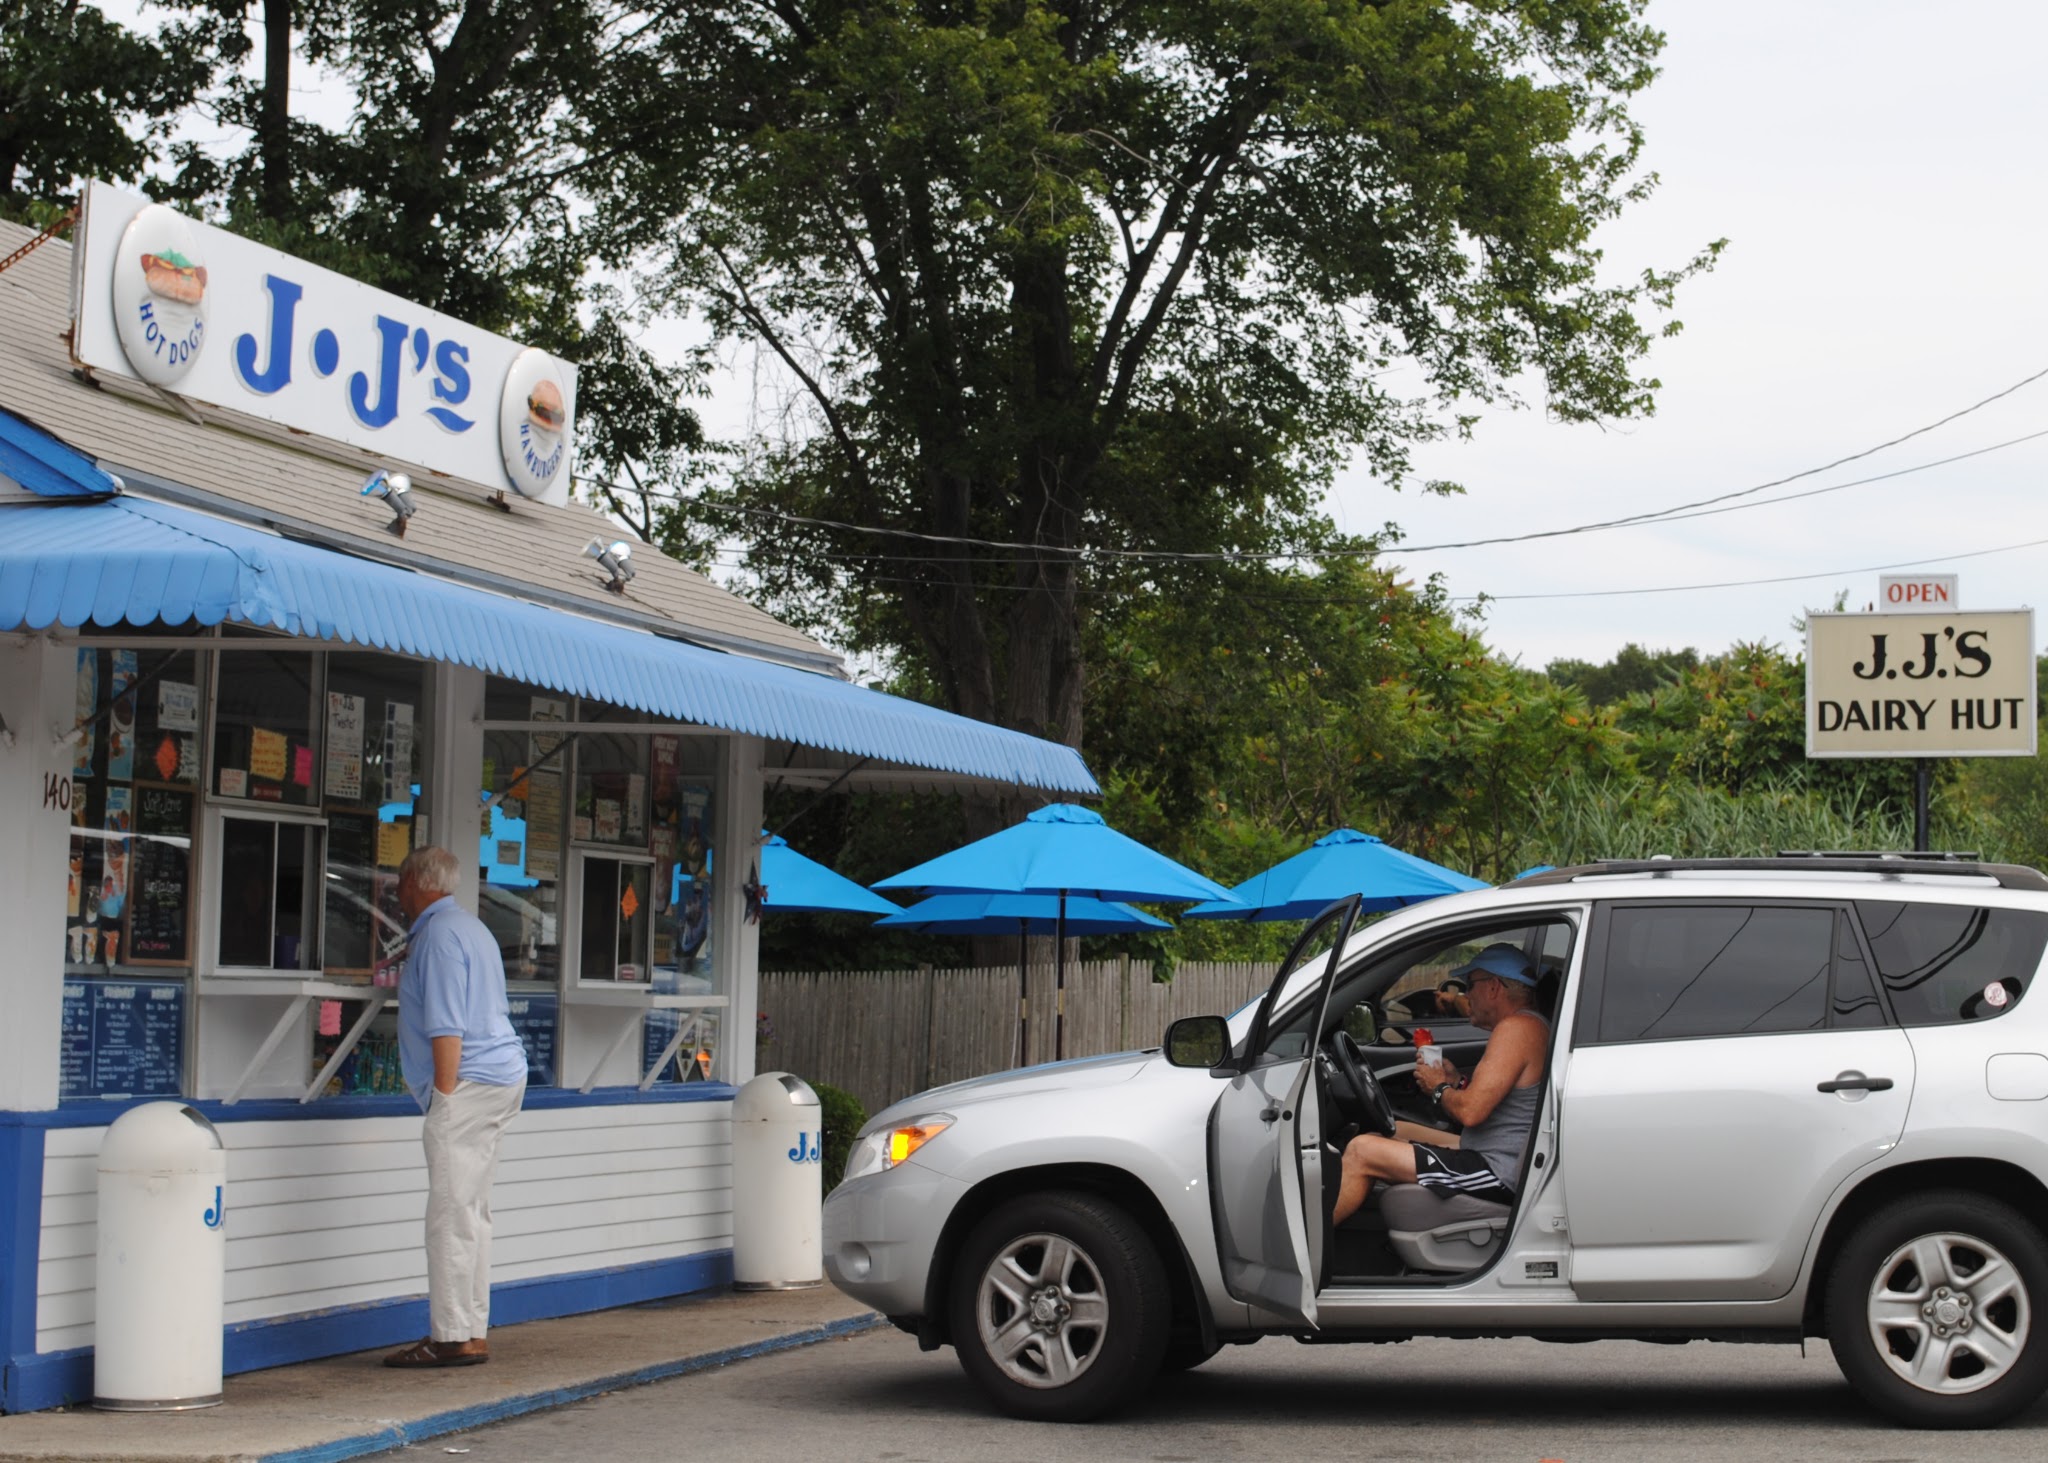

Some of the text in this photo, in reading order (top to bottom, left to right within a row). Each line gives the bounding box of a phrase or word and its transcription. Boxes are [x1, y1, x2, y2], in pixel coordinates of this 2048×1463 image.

[140, 302, 204, 365] HOT DOGS
[1887, 583, 1948, 603] OPEN
[1818, 698, 2025, 732] DAIRY HUT
[43, 771, 71, 811] 140
